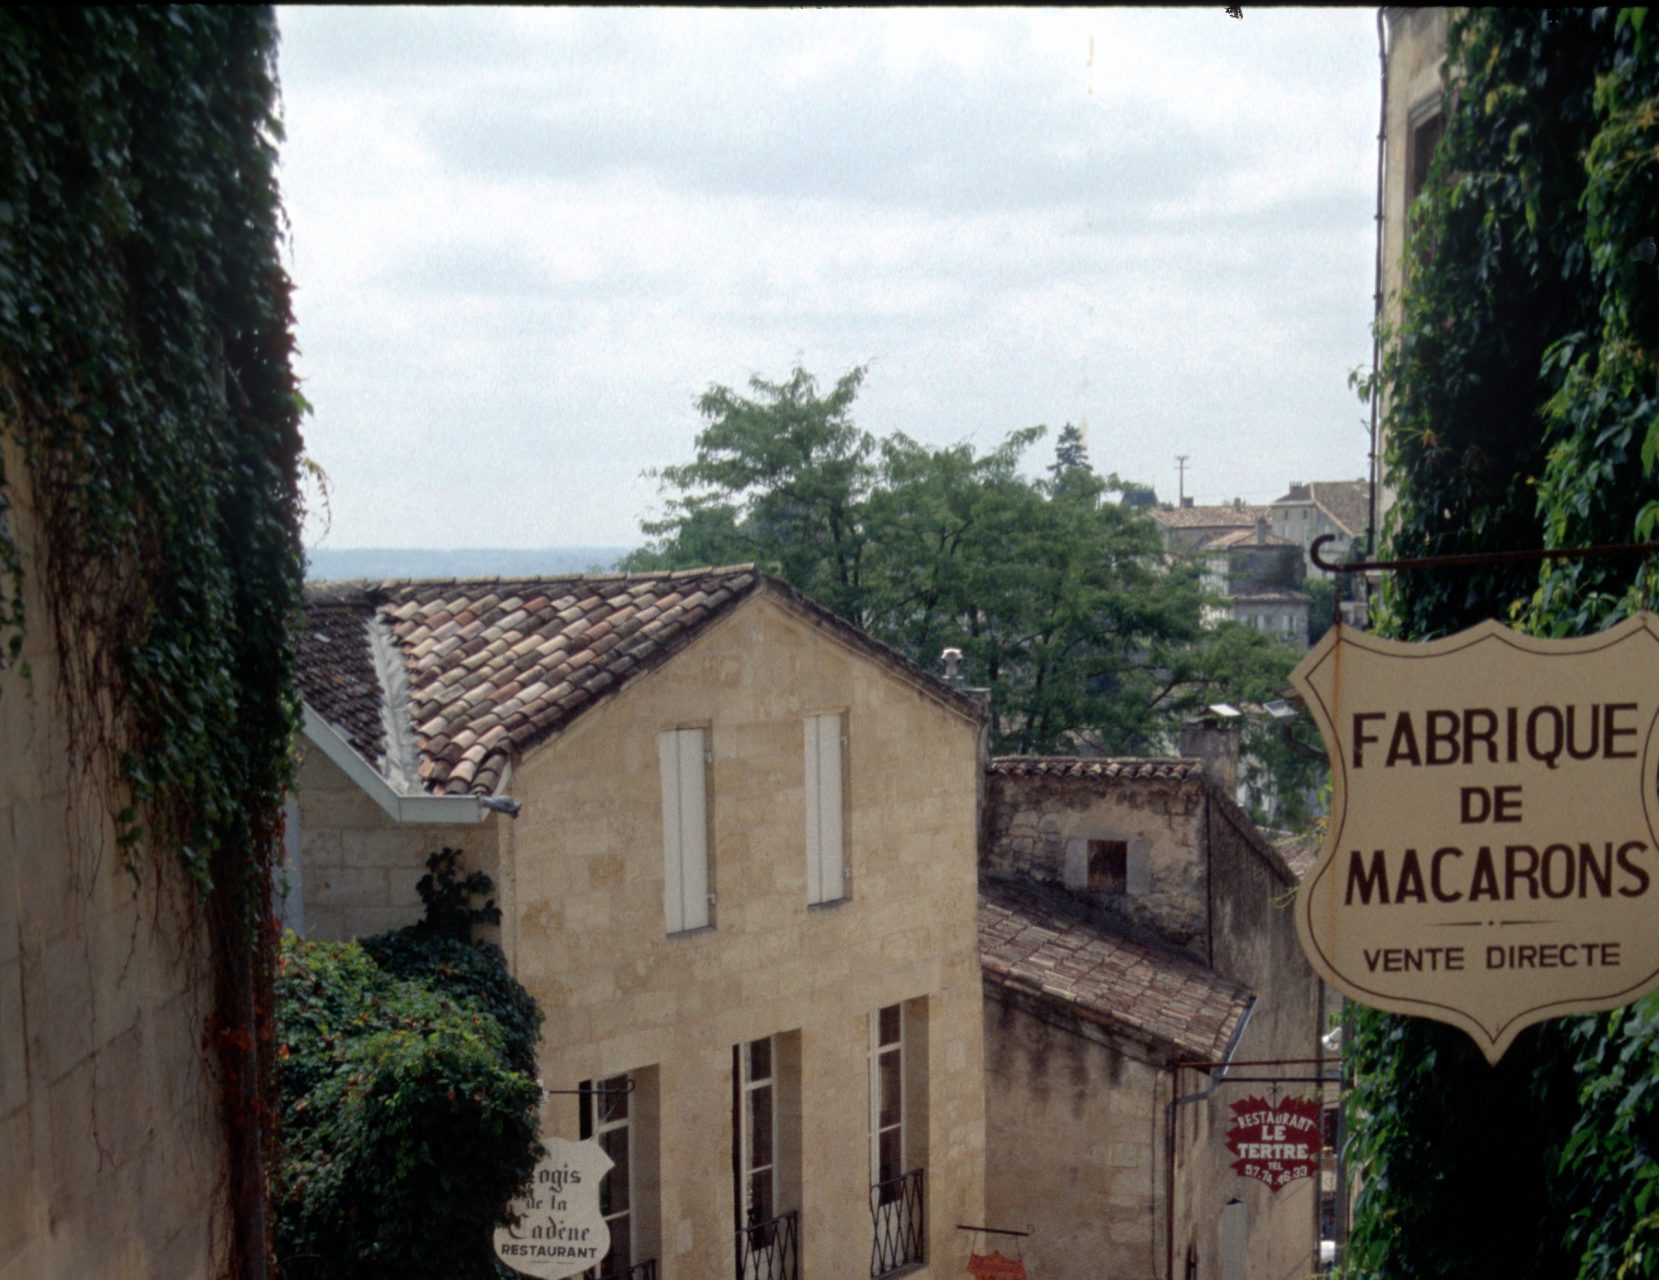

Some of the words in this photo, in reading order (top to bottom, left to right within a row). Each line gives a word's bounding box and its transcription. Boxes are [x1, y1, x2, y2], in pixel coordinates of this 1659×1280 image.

[1352, 702, 1638, 770] FABRIQUE
[1460, 785, 1523, 825] DE
[1343, 840, 1651, 906] MACARONS
[1363, 947, 1465, 973] VENTE
[1485, 942, 1621, 970] DIRECTE
[1237, 1111, 1315, 1132] RESTAURANT
[1261, 1125, 1287, 1141] LE
[1237, 1142, 1309, 1160] TERTRE
[530, 1162, 582, 1193] ogis
[550, 1195, 567, 1211] la
[501, 1243, 598, 1259] RESTAURANT
